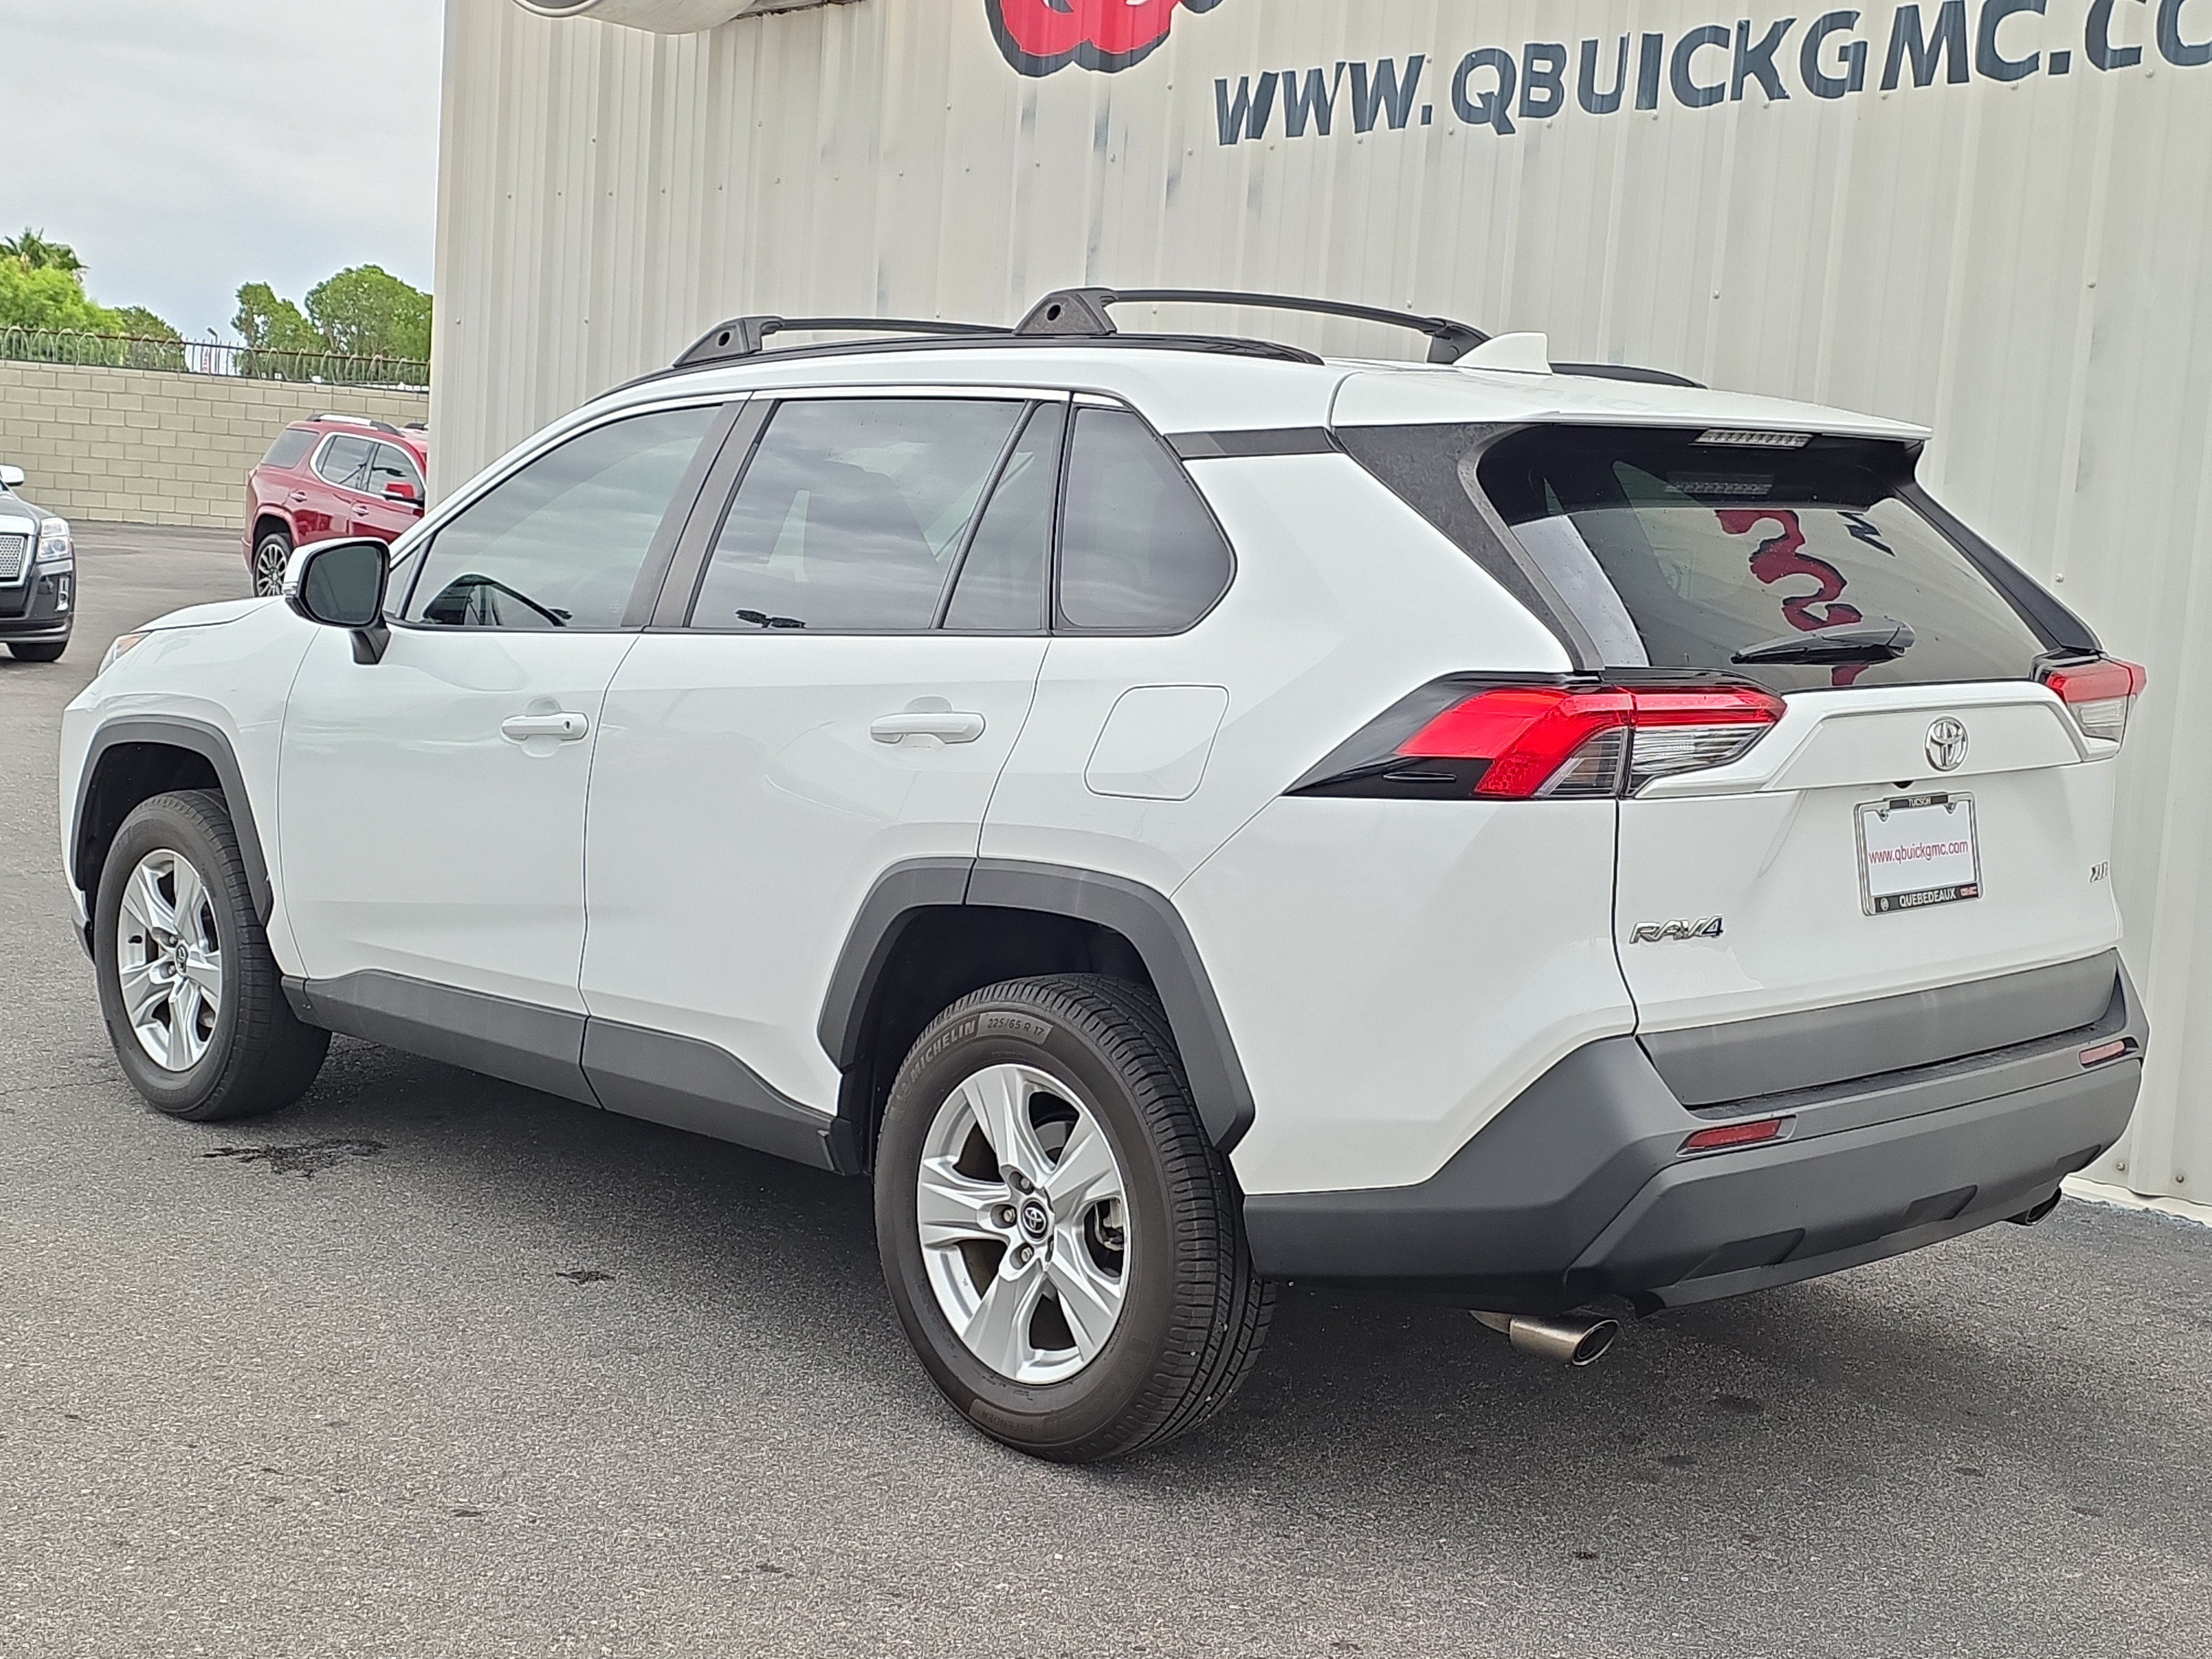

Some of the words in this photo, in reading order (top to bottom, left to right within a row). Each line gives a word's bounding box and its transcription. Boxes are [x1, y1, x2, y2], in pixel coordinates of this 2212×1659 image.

[1908, 796, 1931, 807] TUCSON
[1869, 841, 1968, 864] www.qbuickgmc.com
[1899, 887, 1957, 908] QUEBEDEAUX
[1629, 915, 1724, 944] RAV4
[987, 1017, 1021, 1030] 225/65
[1024, 1022, 1031, 1031] R
[1032, 1025, 1044, 1036] 17
[910, 1020, 976, 1083] MICHELIN
